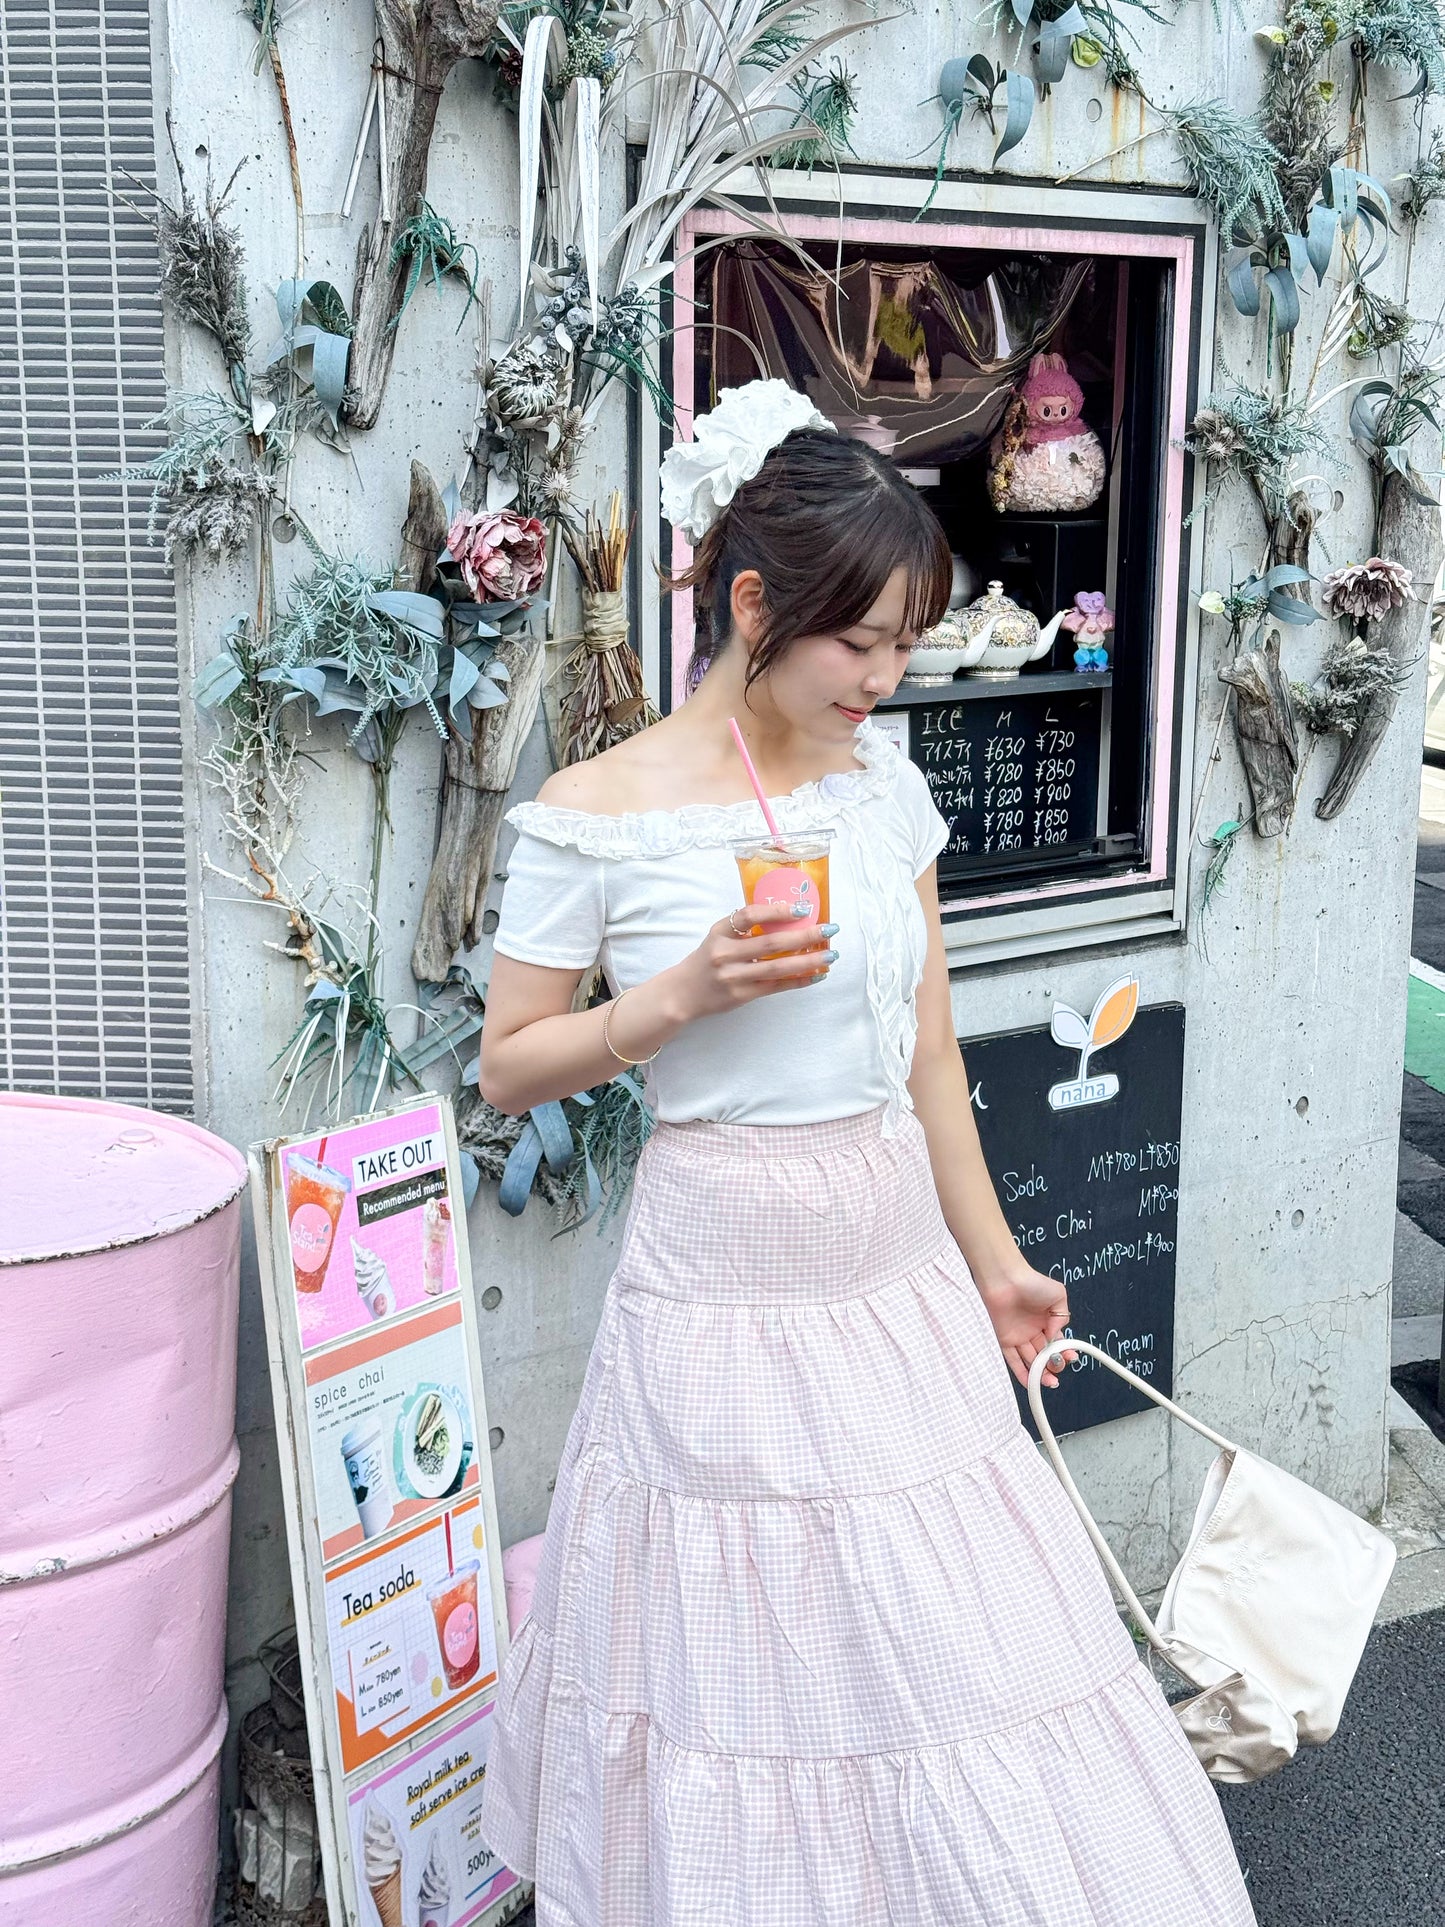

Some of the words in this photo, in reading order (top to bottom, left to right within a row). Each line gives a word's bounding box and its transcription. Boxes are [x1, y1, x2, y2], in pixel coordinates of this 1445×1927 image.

[996, 711, 1012, 728] M
[1045, 708, 1059, 722] L
[920, 739, 972, 762] アイスティ
[984, 736, 1026, 761] ¥630
[1035, 730, 1075, 754] ¥730
[984, 762, 1023, 784] ¥780
[1036, 758, 1076, 782] ¥850
[984, 786, 1022, 807] ¥820
[1034, 783, 1071, 805] ¥900
[984, 810, 1024, 833] ¥780
[1033, 809, 1068, 833] ¥850
[1061, 1083, 1106, 1104] nana
[358, 1150, 397, 1182] TAKE
[402, 1139, 432, 1168] OUT
[363, 1184, 422, 1216] Recommended
[423, 1180, 445, 1196] menu
[1003, 1163, 1048, 1202] Soda
[1056, 1209, 1092, 1238] Chai
[314, 1385, 347, 1409] spice
[358, 1366, 384, 1389] chai
[343, 1592, 373, 1620] Tea
[379, 1563, 415, 1602] soda
[407, 1770, 432, 1801] Royal
[434, 1757, 453, 1782] milk
[454, 1751, 470, 1768] tea
[410, 1802, 427, 1826] soft
[429, 1788, 452, 1812] serve
[454, 1779, 468, 1793] ice
